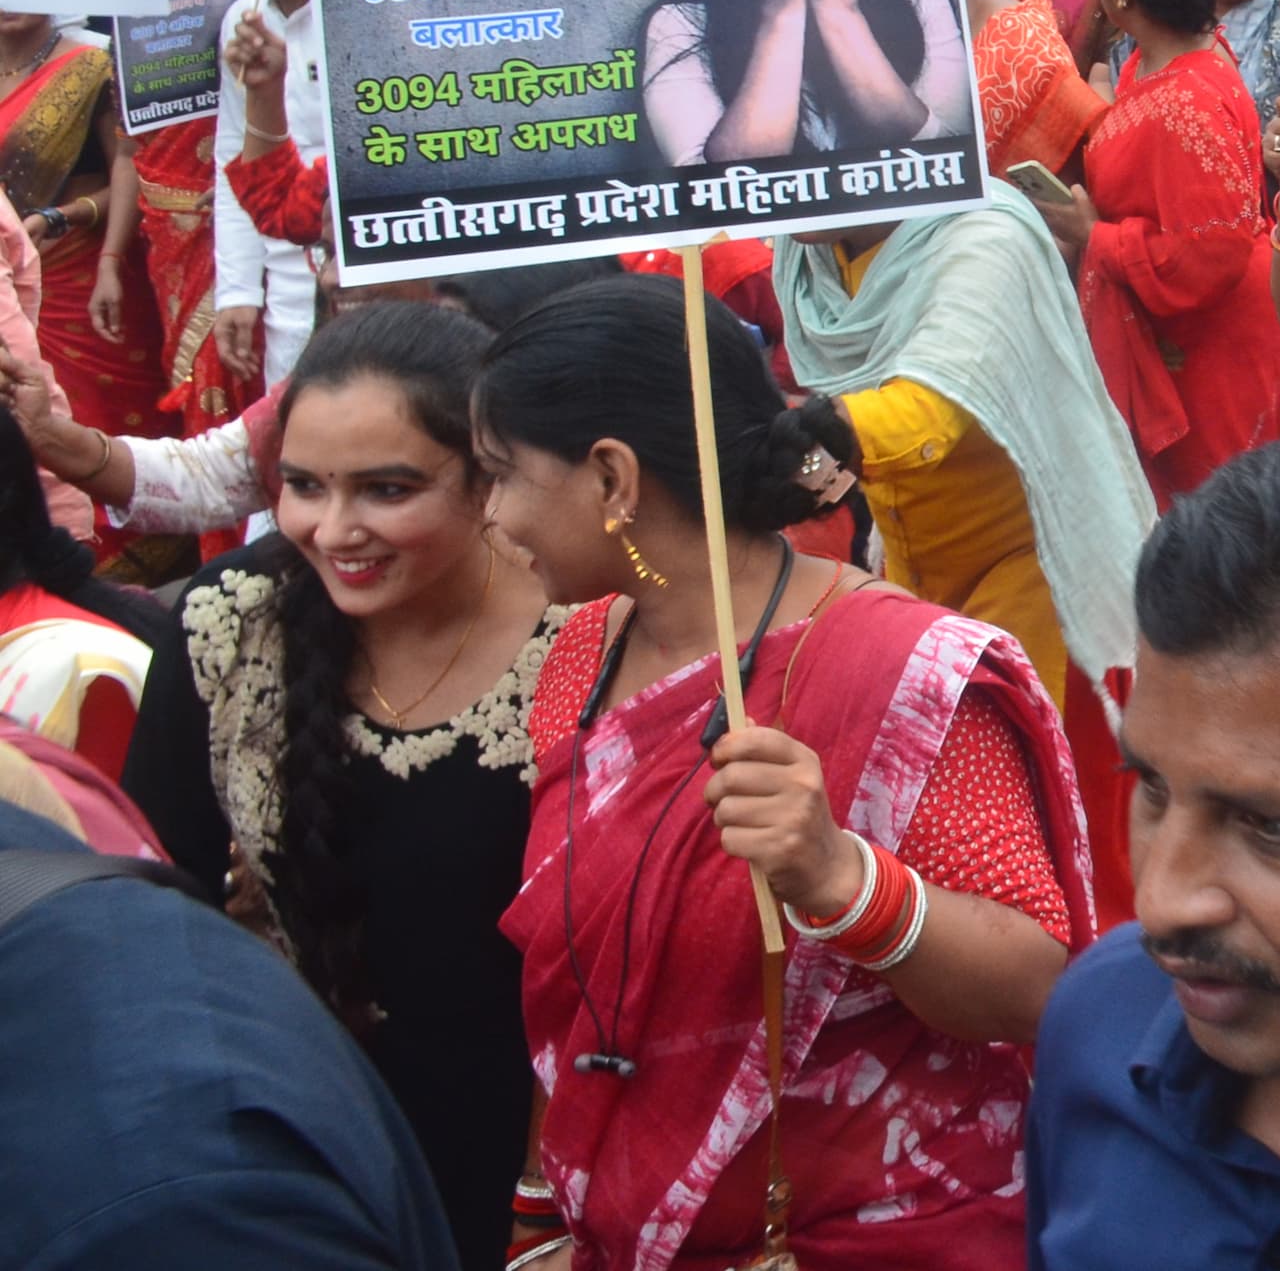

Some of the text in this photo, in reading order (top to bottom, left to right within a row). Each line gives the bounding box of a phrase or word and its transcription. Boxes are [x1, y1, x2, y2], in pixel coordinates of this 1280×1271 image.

[410, 8, 564, 49] बलात्कार
[355, 49, 637, 114] 3094 महिलाओं
[364, 113, 638, 167] के साथ अपराध
[348, 149, 966, 249] छत्तीसगढ़ प्रदेश महिला कांग्रेस
